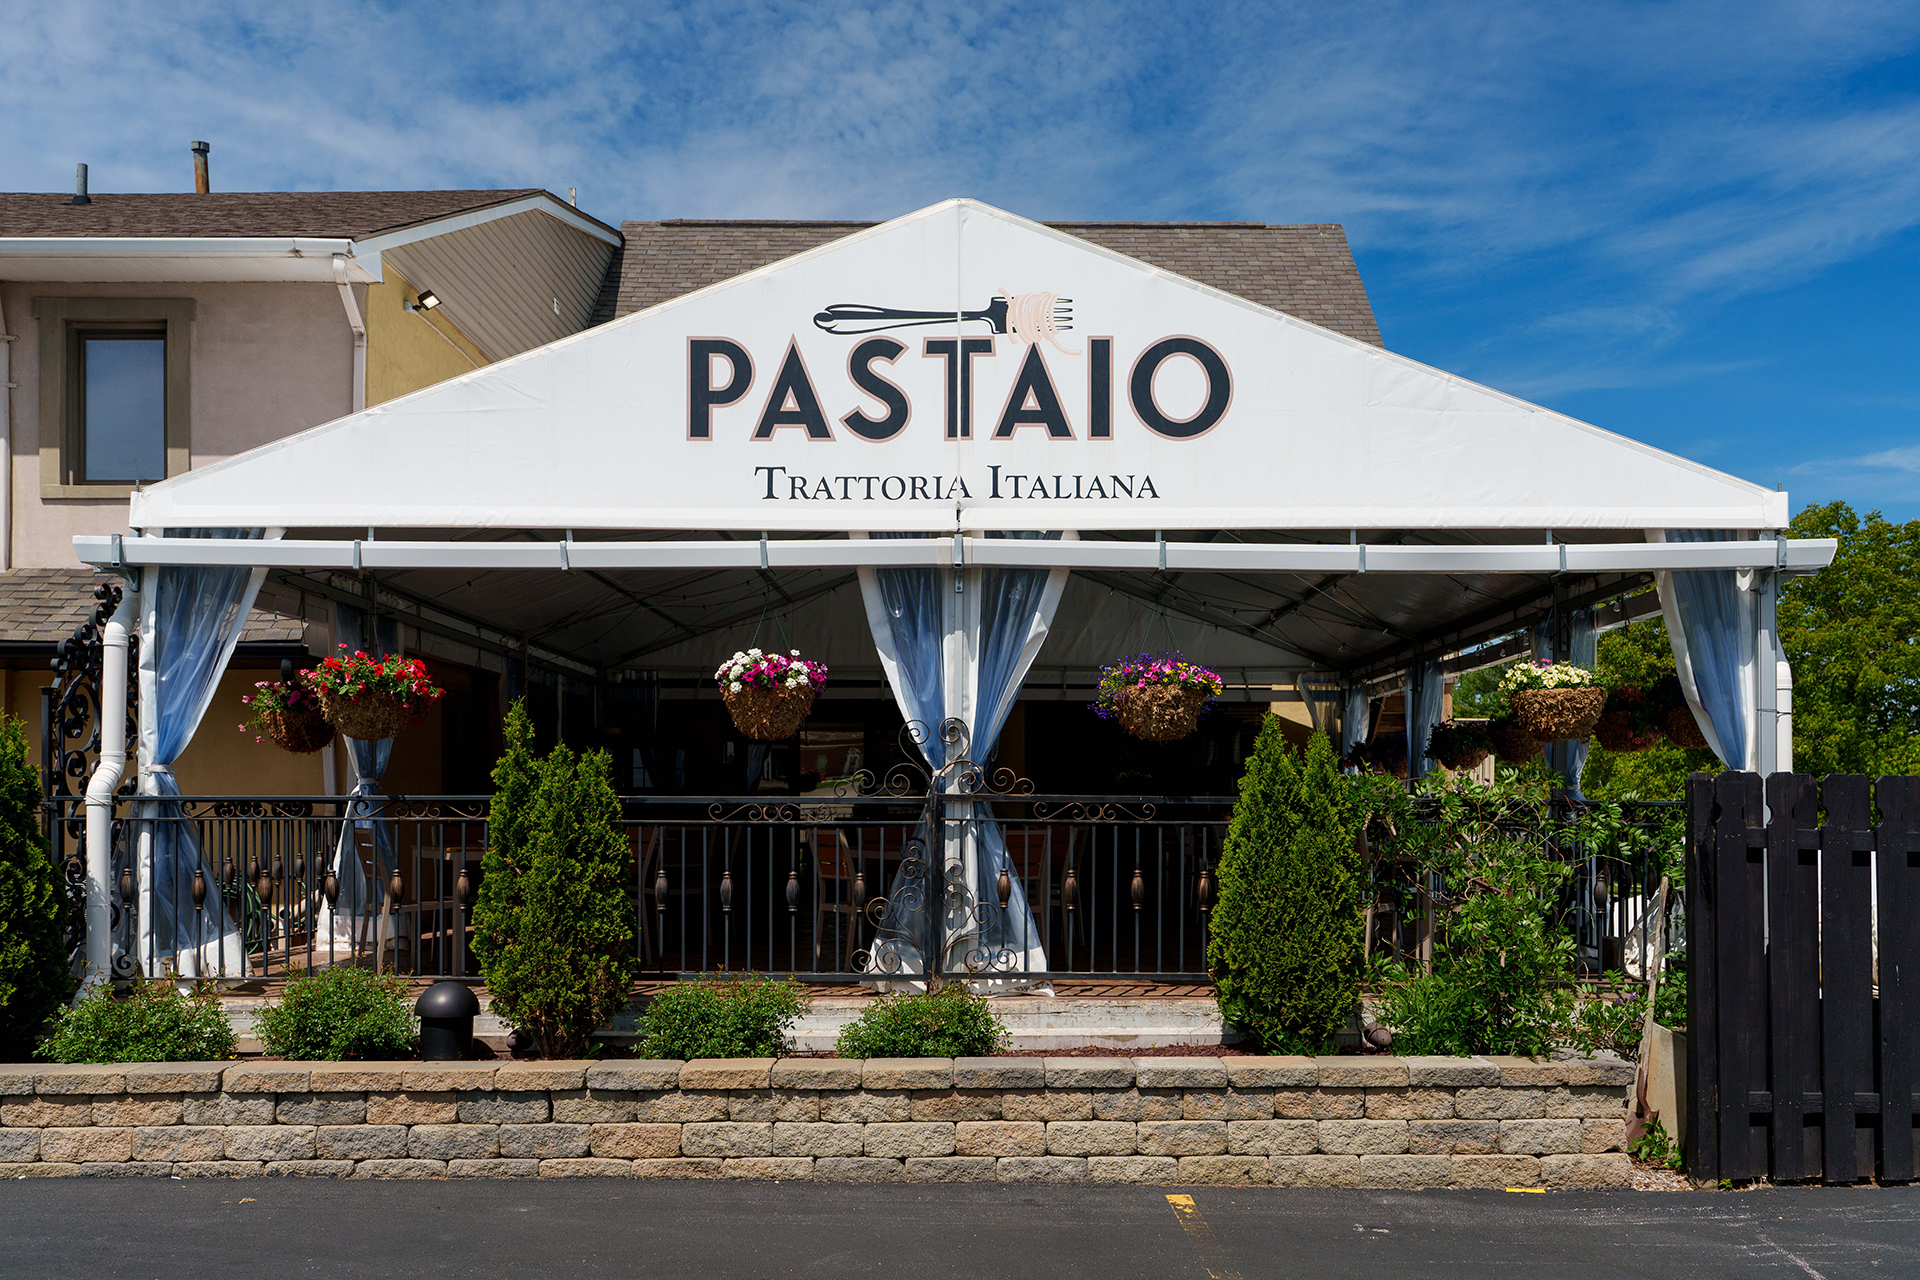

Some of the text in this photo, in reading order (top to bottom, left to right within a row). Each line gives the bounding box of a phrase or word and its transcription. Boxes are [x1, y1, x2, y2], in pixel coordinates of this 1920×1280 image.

[686, 333, 1234, 443] PASTAIO
[754, 465, 1160, 500] TRATTORIA ITALIANA
